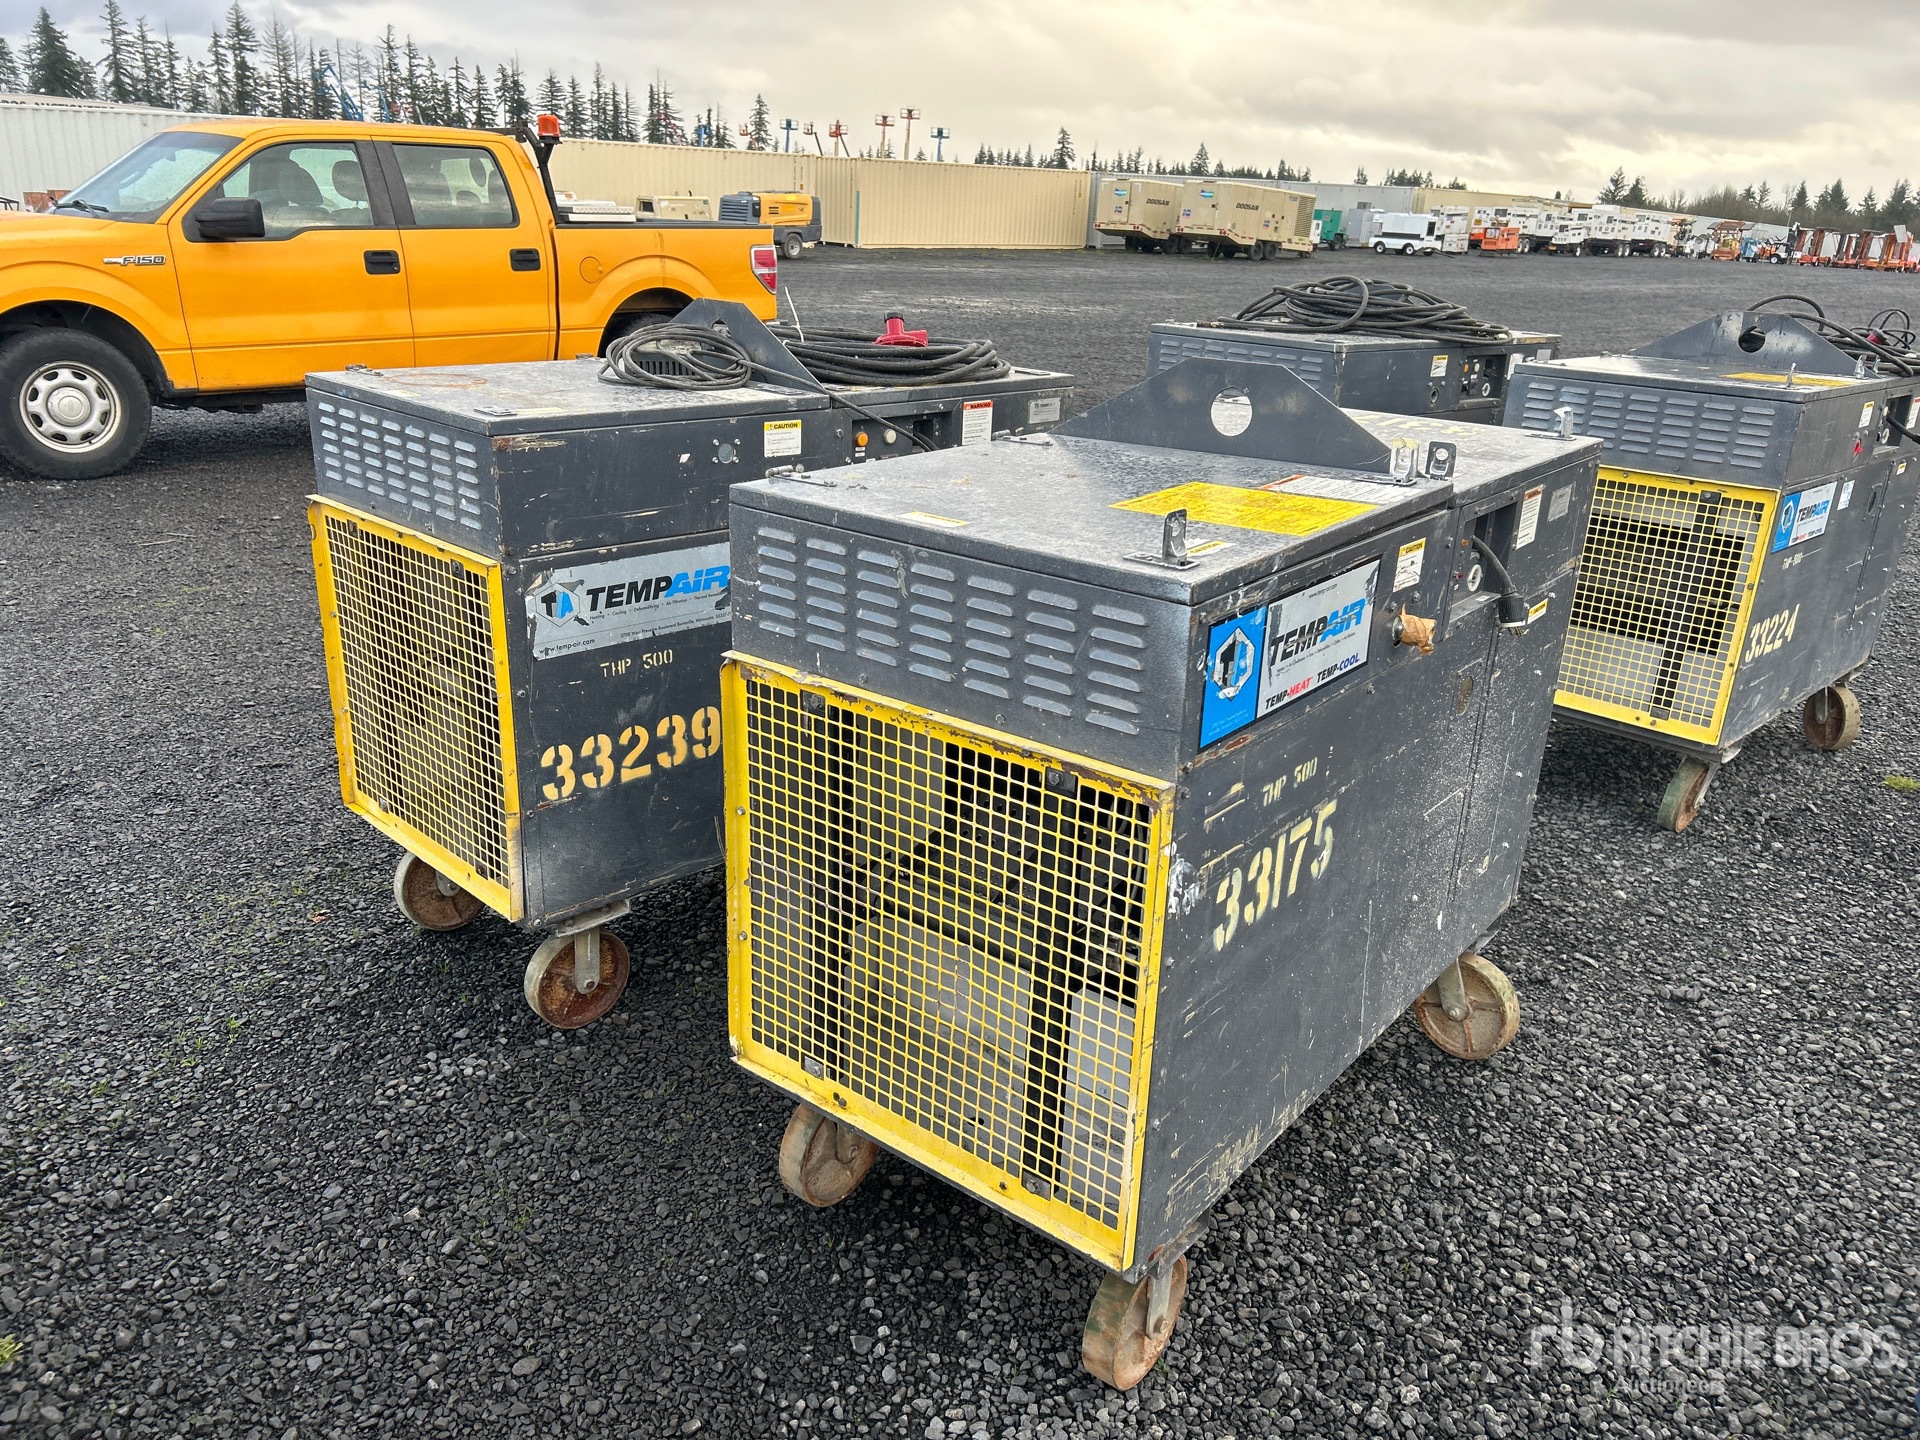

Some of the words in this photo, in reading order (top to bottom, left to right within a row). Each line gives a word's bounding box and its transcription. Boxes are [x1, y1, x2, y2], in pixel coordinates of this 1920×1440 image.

[1235, 202, 1260, 212] DOOSAN
[121, 254, 166, 266] F-150
[773, 422, 799, 430] CAUTION
[1405, 542, 1424, 555] CAUTION
[586, 565, 731, 612] TEMPAIR
[539, 638, 596, 654] ww.temp-air.com
[1270, 598, 1366, 667] TEMPAIR
[1744, 603, 1801, 663] 33224
[600, 659, 631, 679] THP
[643, 649, 673, 669] 500
[1265, 677, 1312, 710] TEMP-HEAT
[1316, 653, 1360, 683] TEMP-COOL
[540, 706, 721, 801] 33239
[1293, 756, 1318, 788] 500
[1213, 798, 1338, 951] 33175
